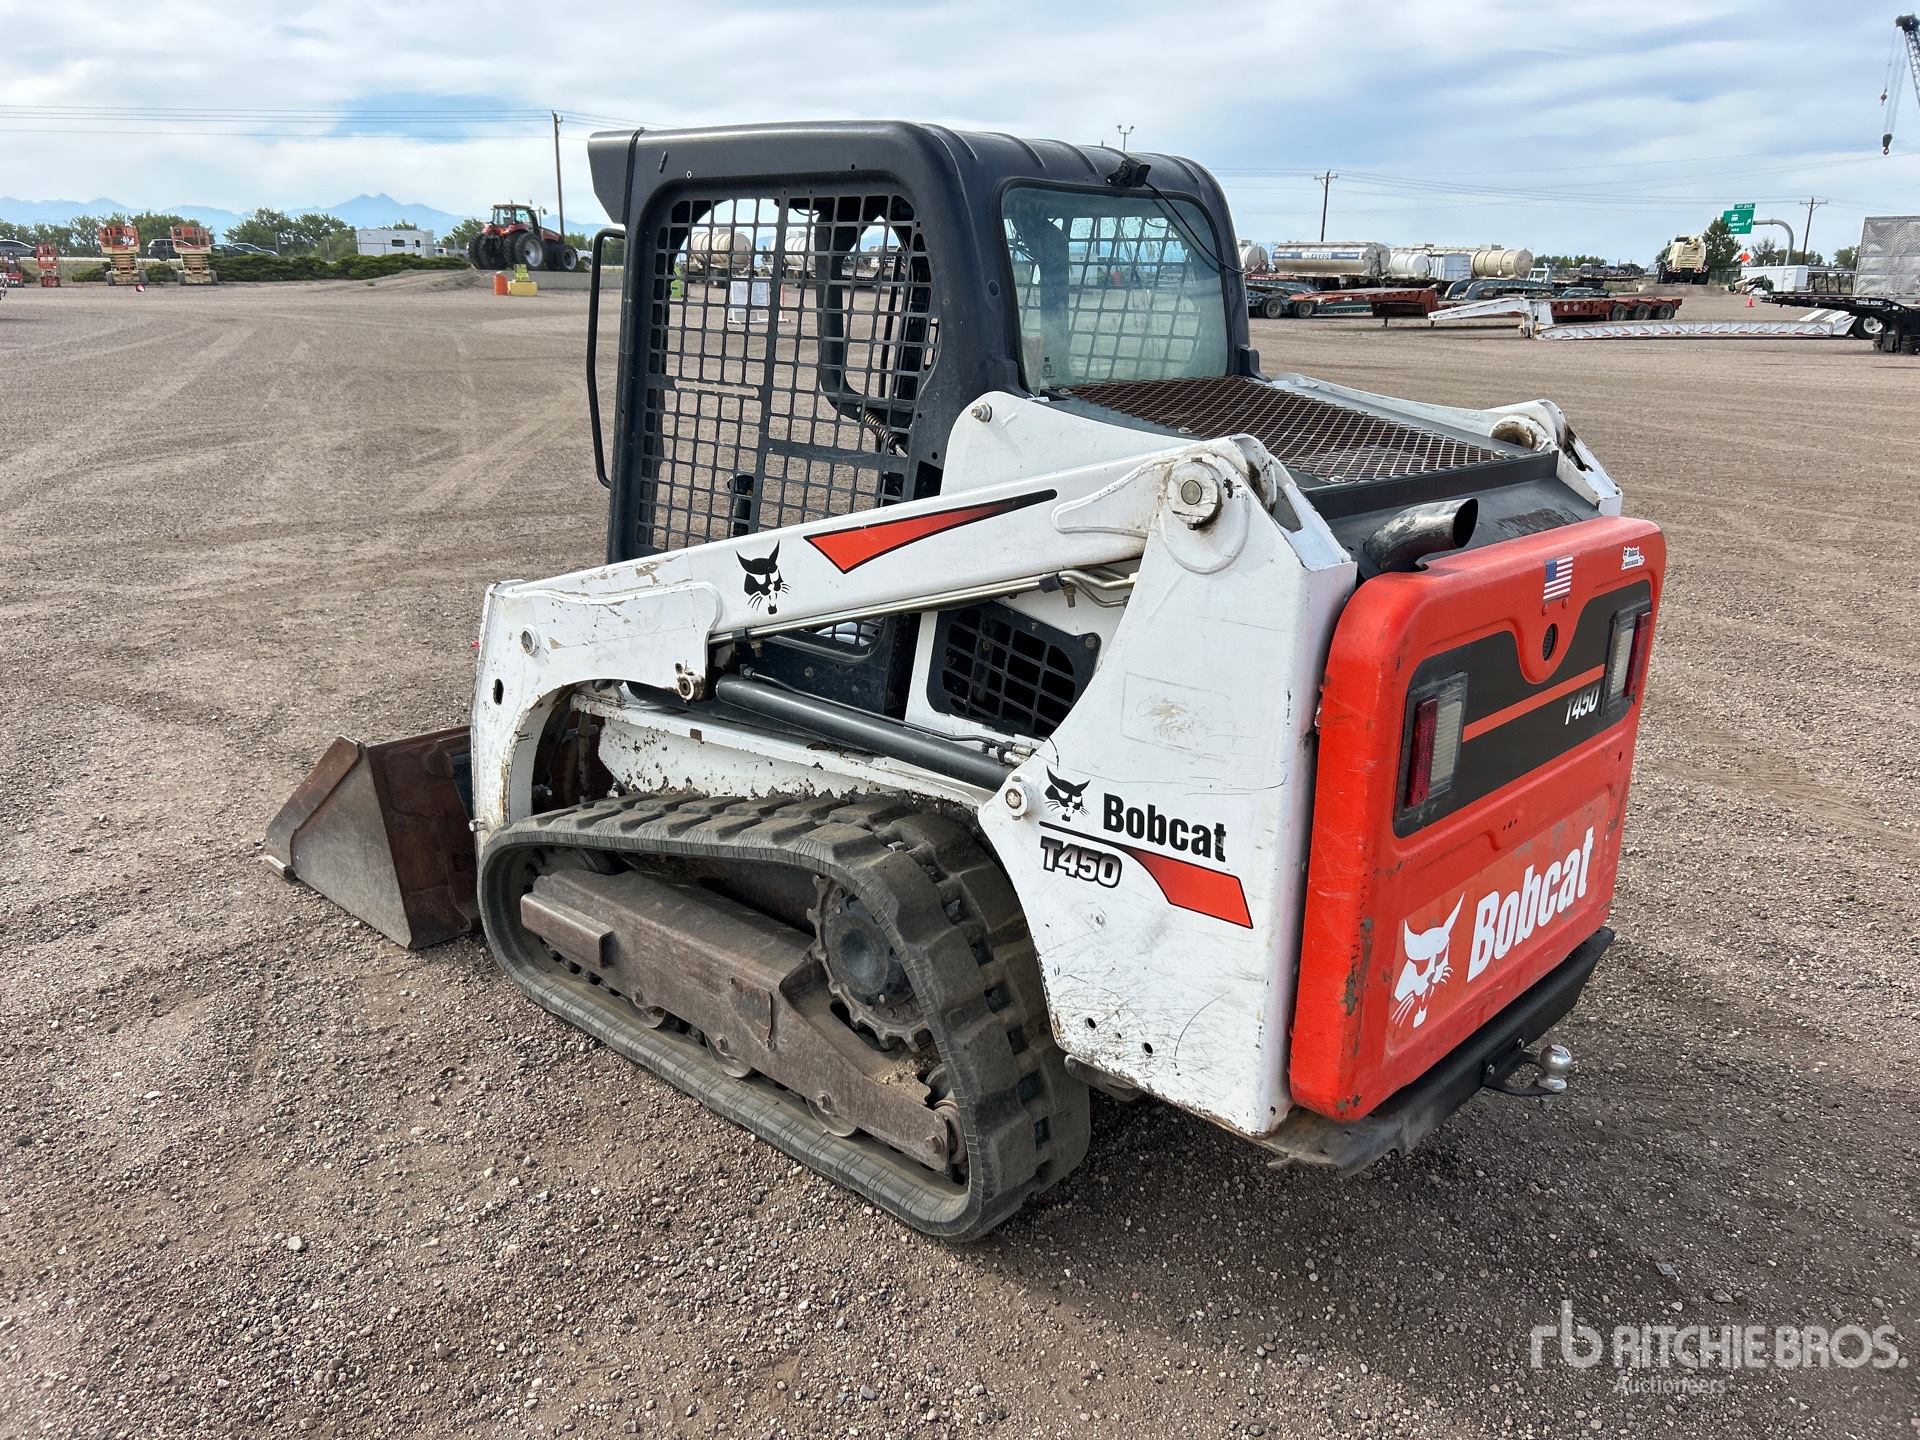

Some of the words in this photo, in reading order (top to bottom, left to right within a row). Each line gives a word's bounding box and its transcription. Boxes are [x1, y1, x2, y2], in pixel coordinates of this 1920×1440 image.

[1565, 686, 1600, 726] T450
[1103, 792, 1226, 862] Bobcat
[1040, 835, 1123, 889] T450
[1467, 826, 1594, 983] Bobcat
